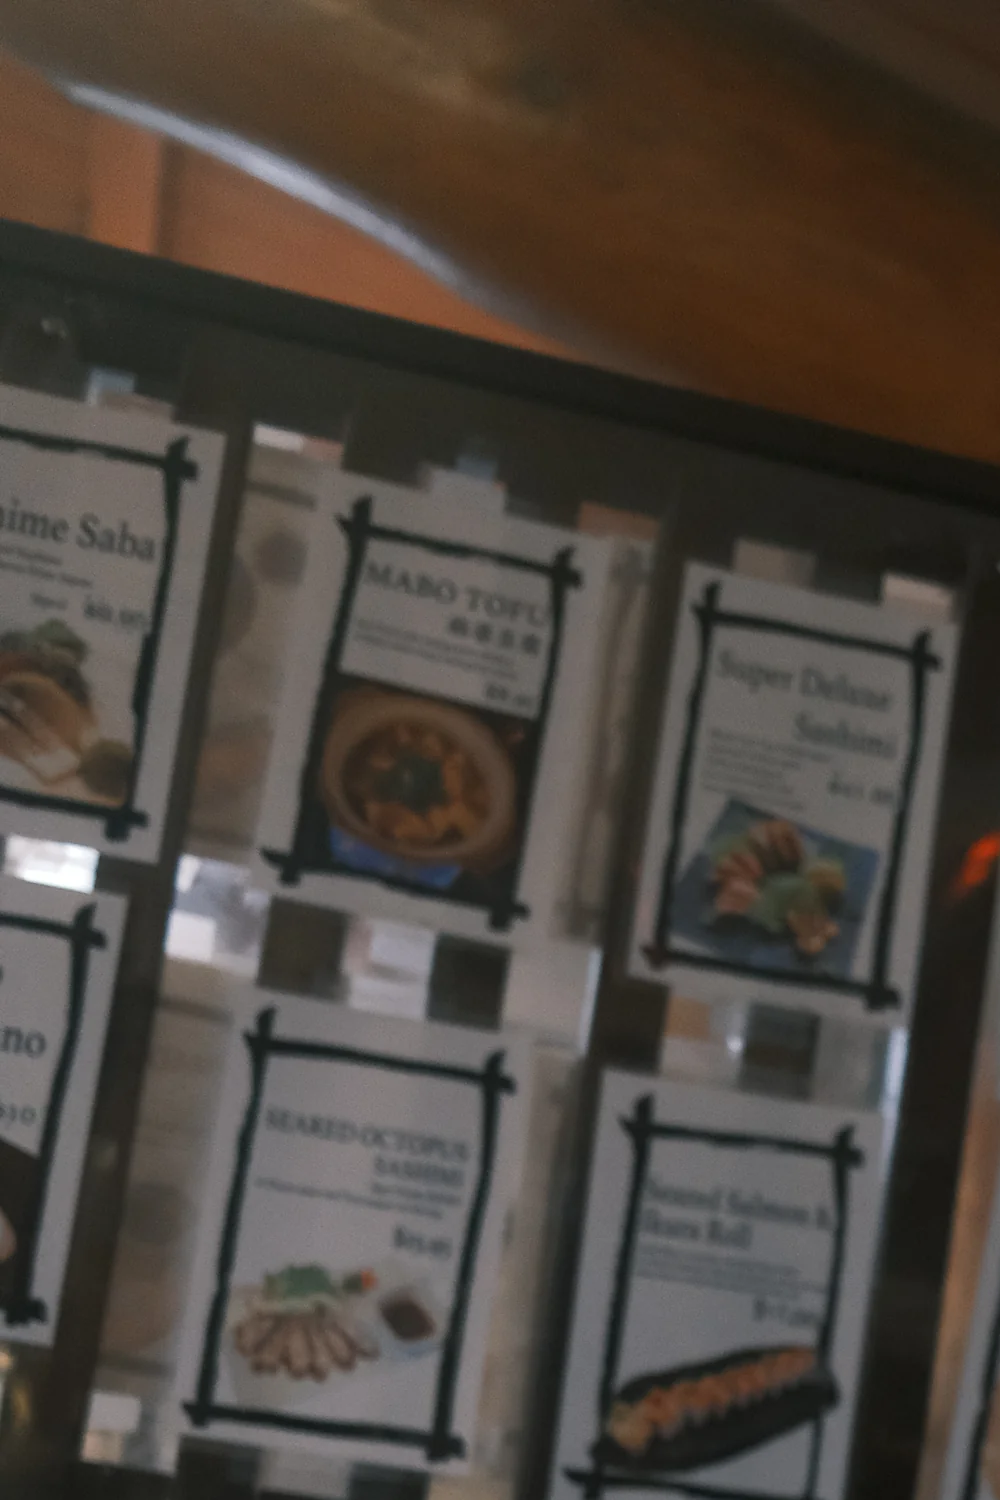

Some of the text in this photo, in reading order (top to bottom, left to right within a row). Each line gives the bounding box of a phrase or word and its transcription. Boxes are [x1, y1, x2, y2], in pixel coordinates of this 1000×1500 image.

[0, 498, 69, 544] ime
[76, 513, 155, 562] Saba
[364, 562, 458, 605] MABO
